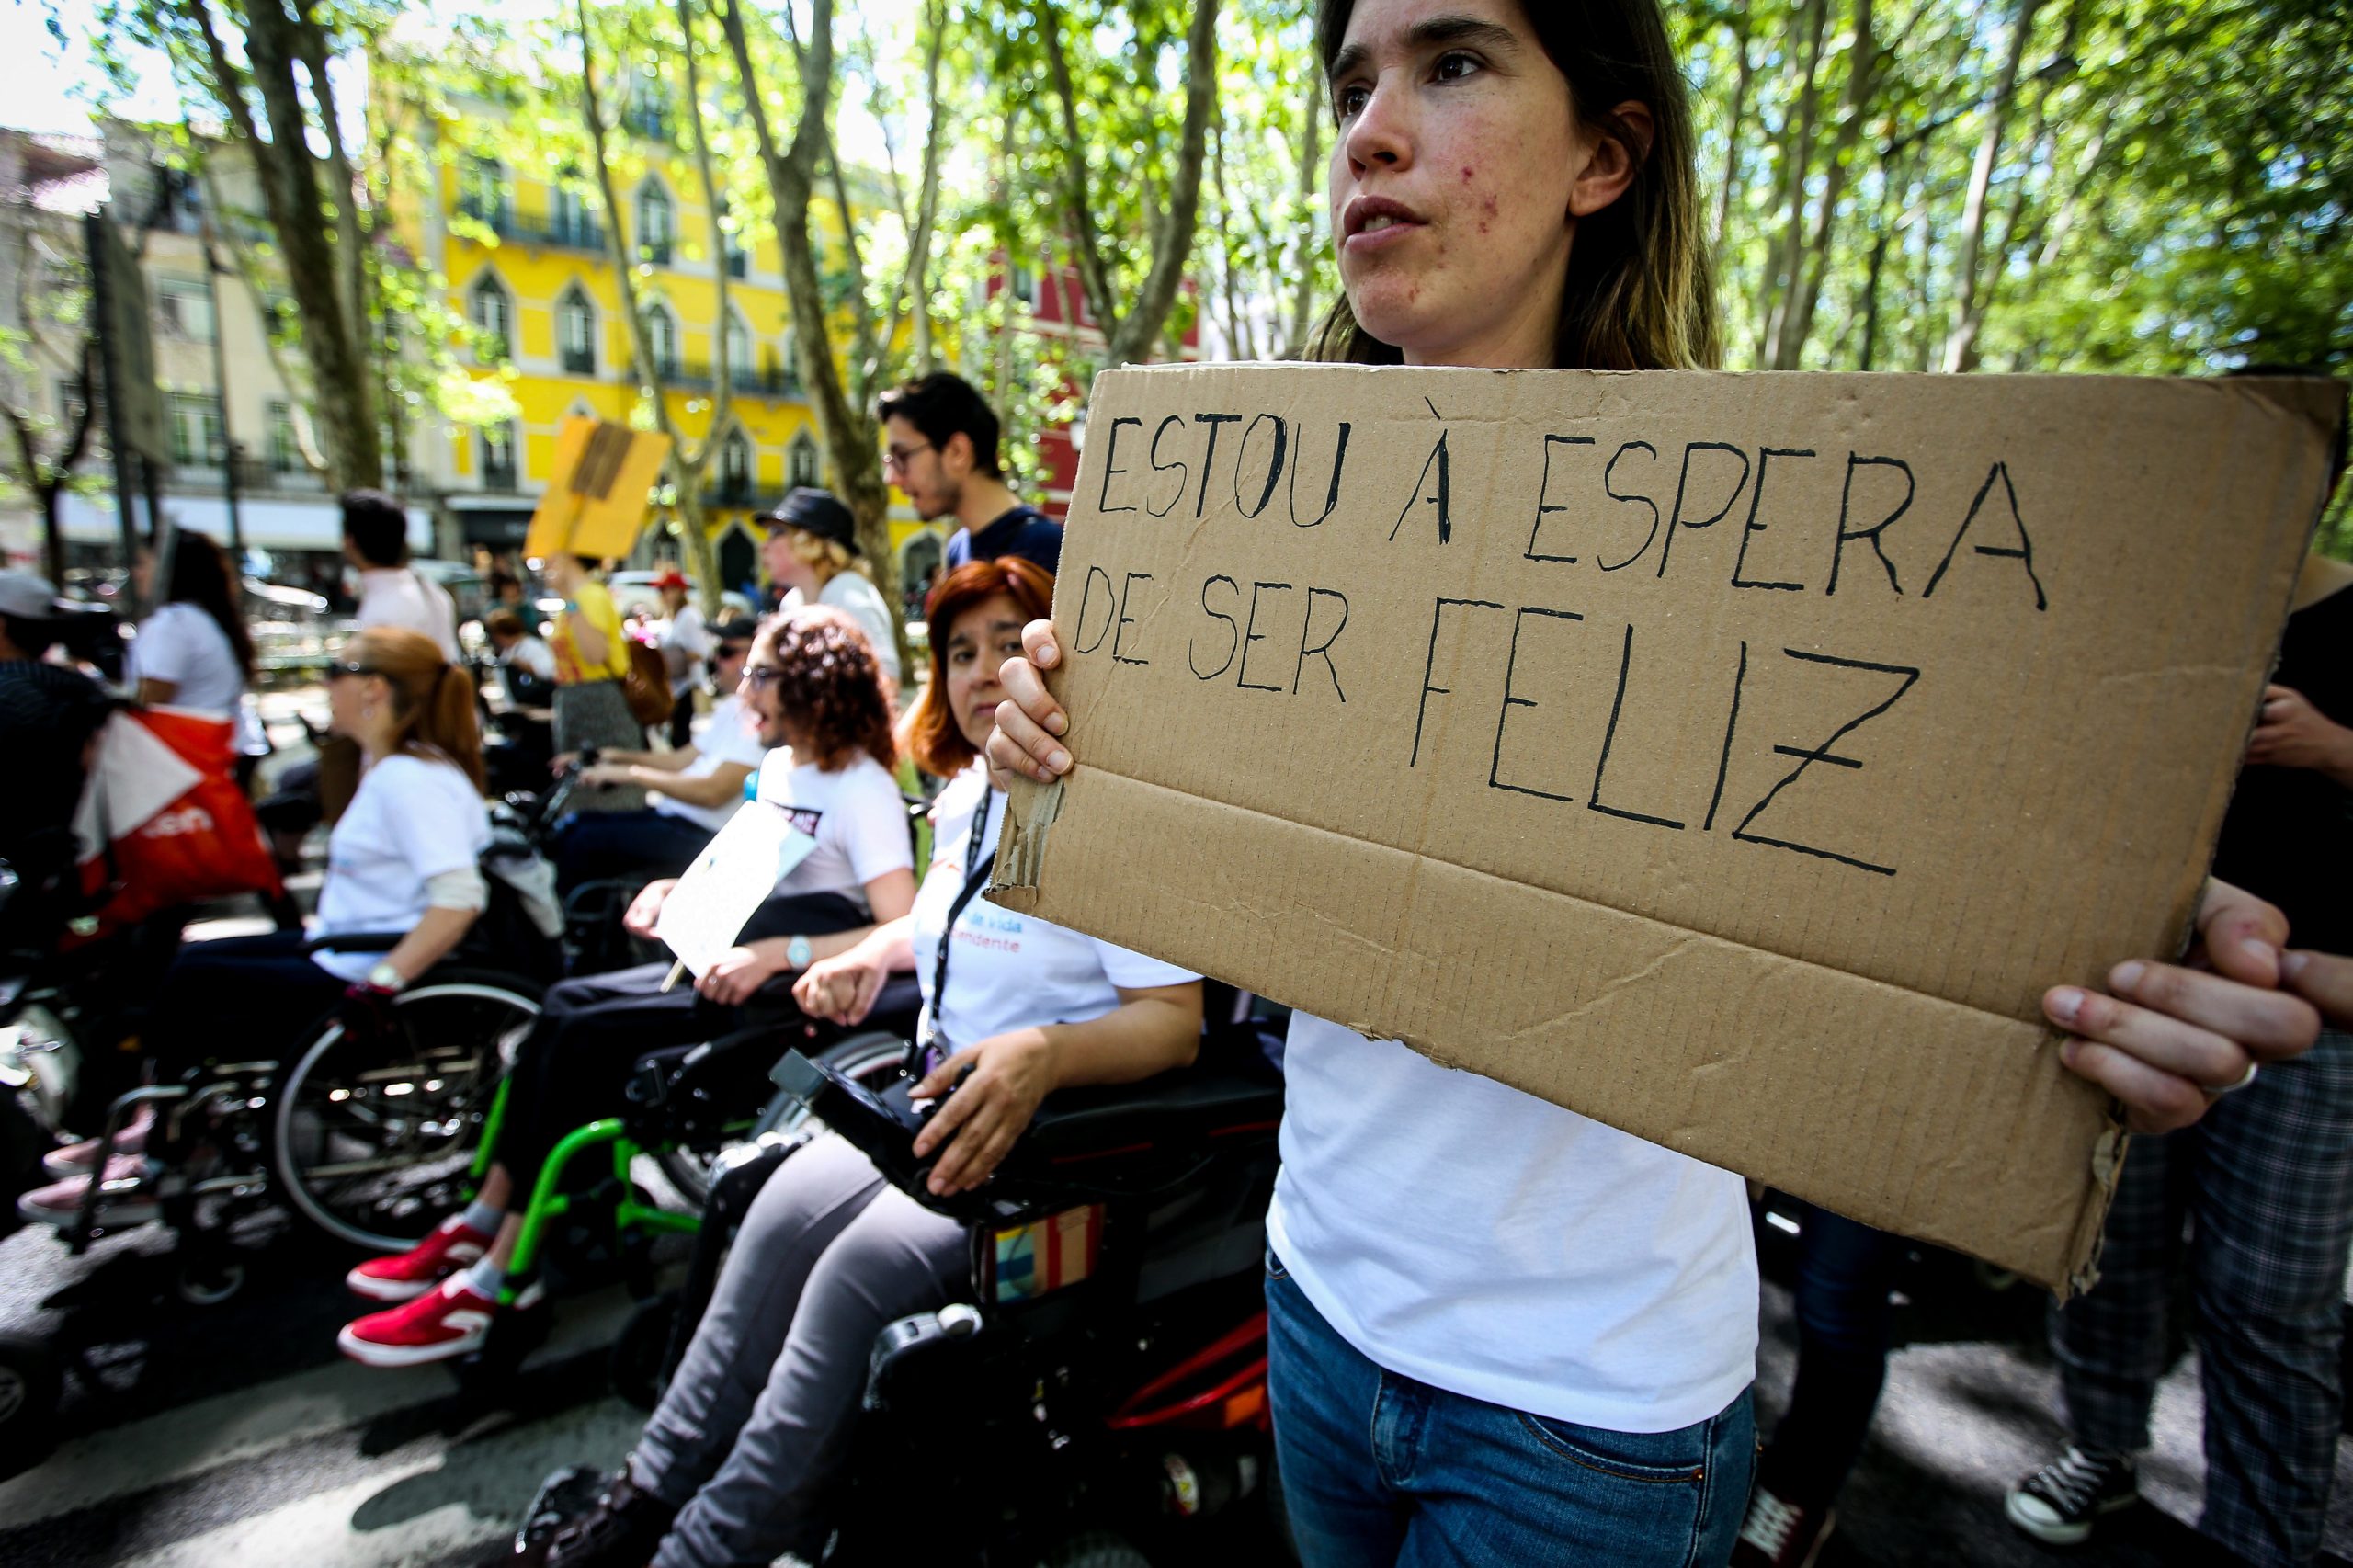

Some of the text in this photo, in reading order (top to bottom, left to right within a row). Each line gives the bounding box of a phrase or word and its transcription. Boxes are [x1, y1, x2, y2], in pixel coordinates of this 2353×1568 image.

[1099, 396, 2048, 611] ESTOU À ESPERA
[1074, 565, 1920, 876] DE SER FELIZ
